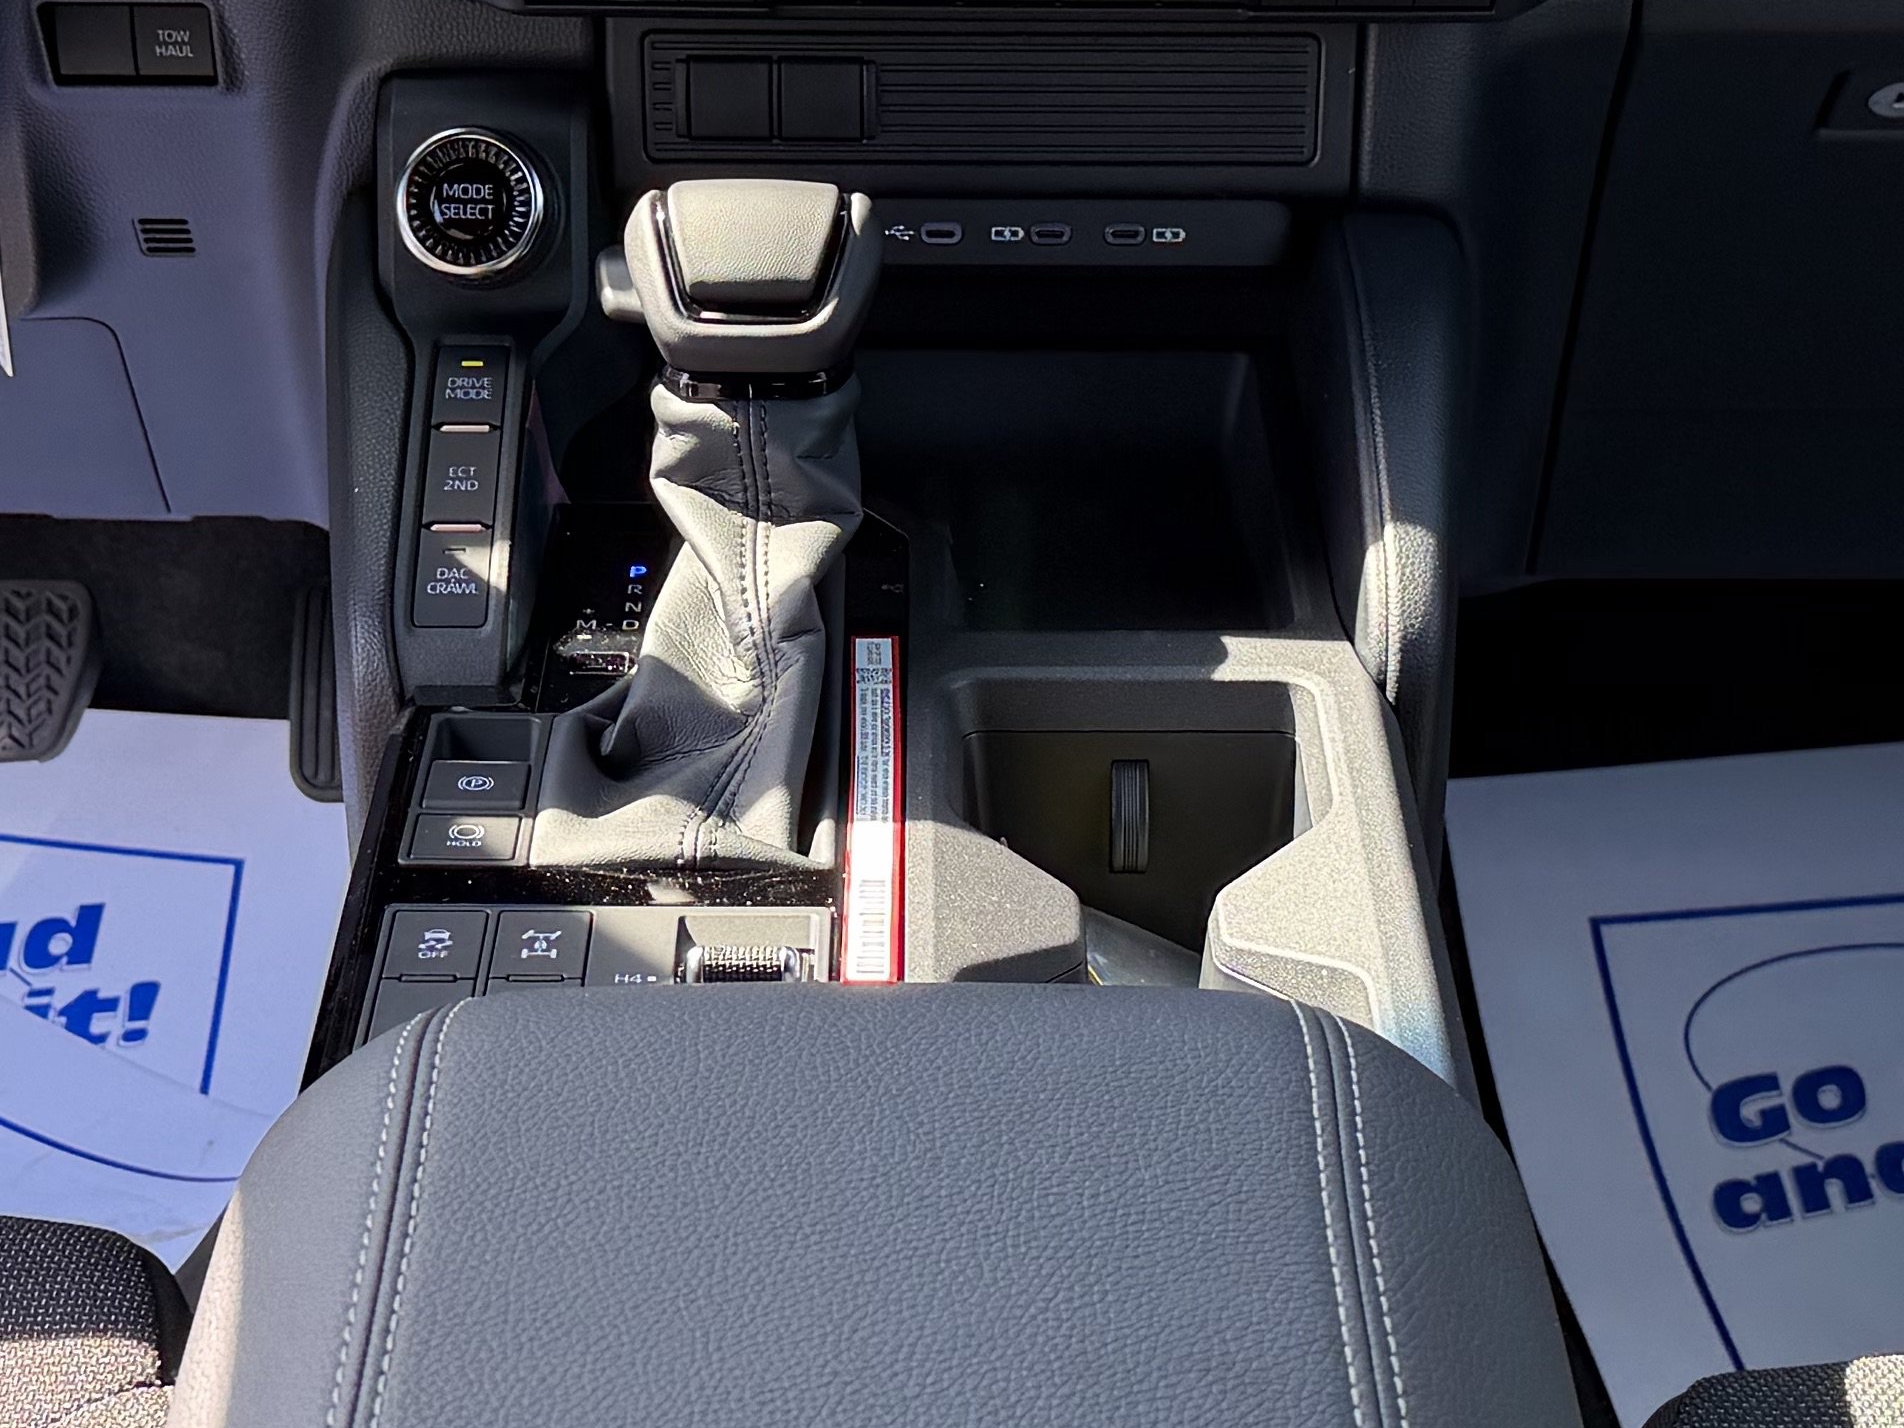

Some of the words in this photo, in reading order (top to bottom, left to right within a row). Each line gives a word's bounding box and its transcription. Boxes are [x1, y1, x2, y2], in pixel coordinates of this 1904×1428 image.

[156, 29, 190, 43] TOW
[155, 44, 194, 58] HAUL
[442, 183, 495, 200] MODE
[440, 203, 496, 221] SELECT
[447, 377, 493, 388] DRIVE
[445, 388, 492, 400] MODE
[449, 466, 477, 477] ECT
[443, 479, 479, 491] 2ND
[436, 567, 470, 579] DAC
[629, 565, 647, 578] P
[427, 581, 479, 595] CRAWL
[627, 584, 643, 595] R
[625, 602, 642, 613] N
[576, 619, 597, 630] M
[621, 619, 640, 631] D
[418, 950, 449, 959] OFF
[614, 973, 642, 983] H4
[1708, 1061, 1867, 1146] Go
